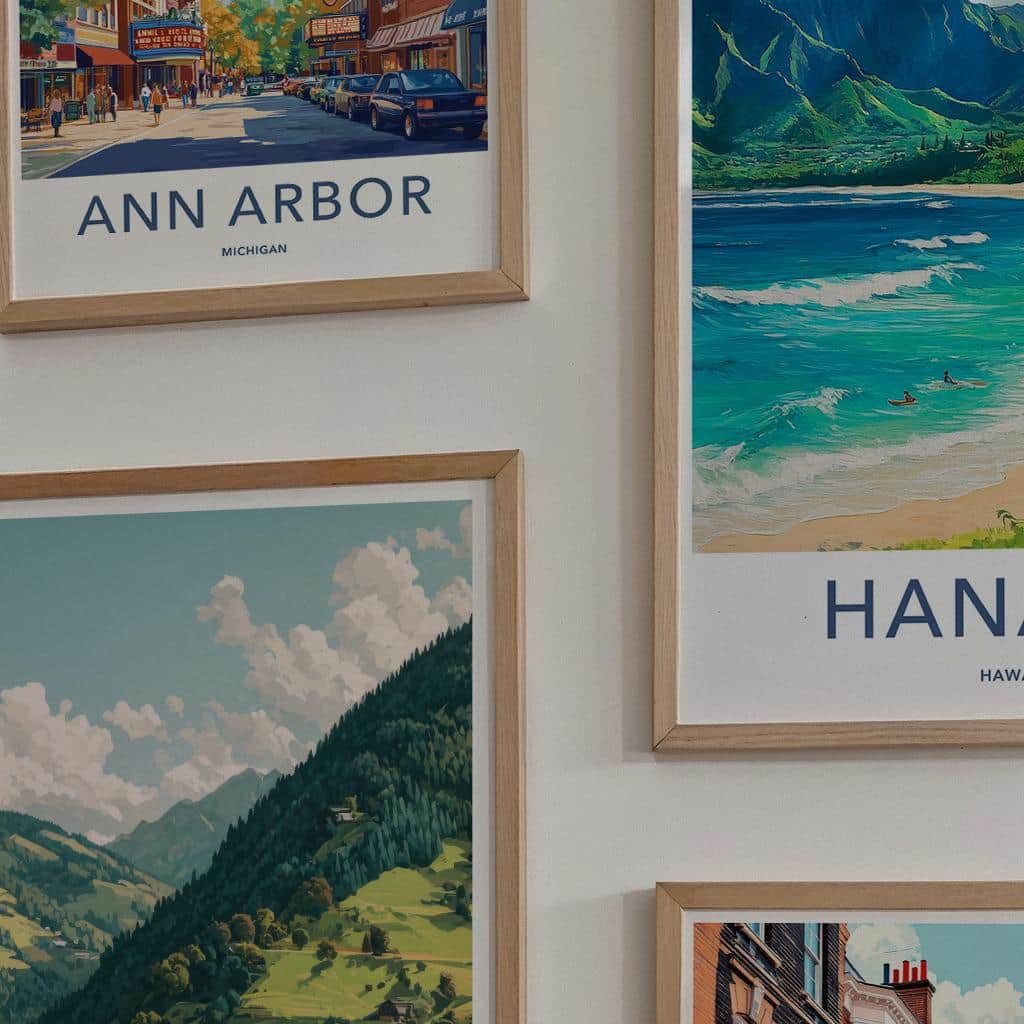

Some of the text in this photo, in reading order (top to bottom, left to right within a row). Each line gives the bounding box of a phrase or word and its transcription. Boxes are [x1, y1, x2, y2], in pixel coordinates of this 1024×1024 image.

[77, 175, 432, 236] ANN ARBOR
[221, 244, 288, 258] MICHIGAN
[827, 577, 1024, 639] HAN
[980, 668, 1024, 682] HAW
